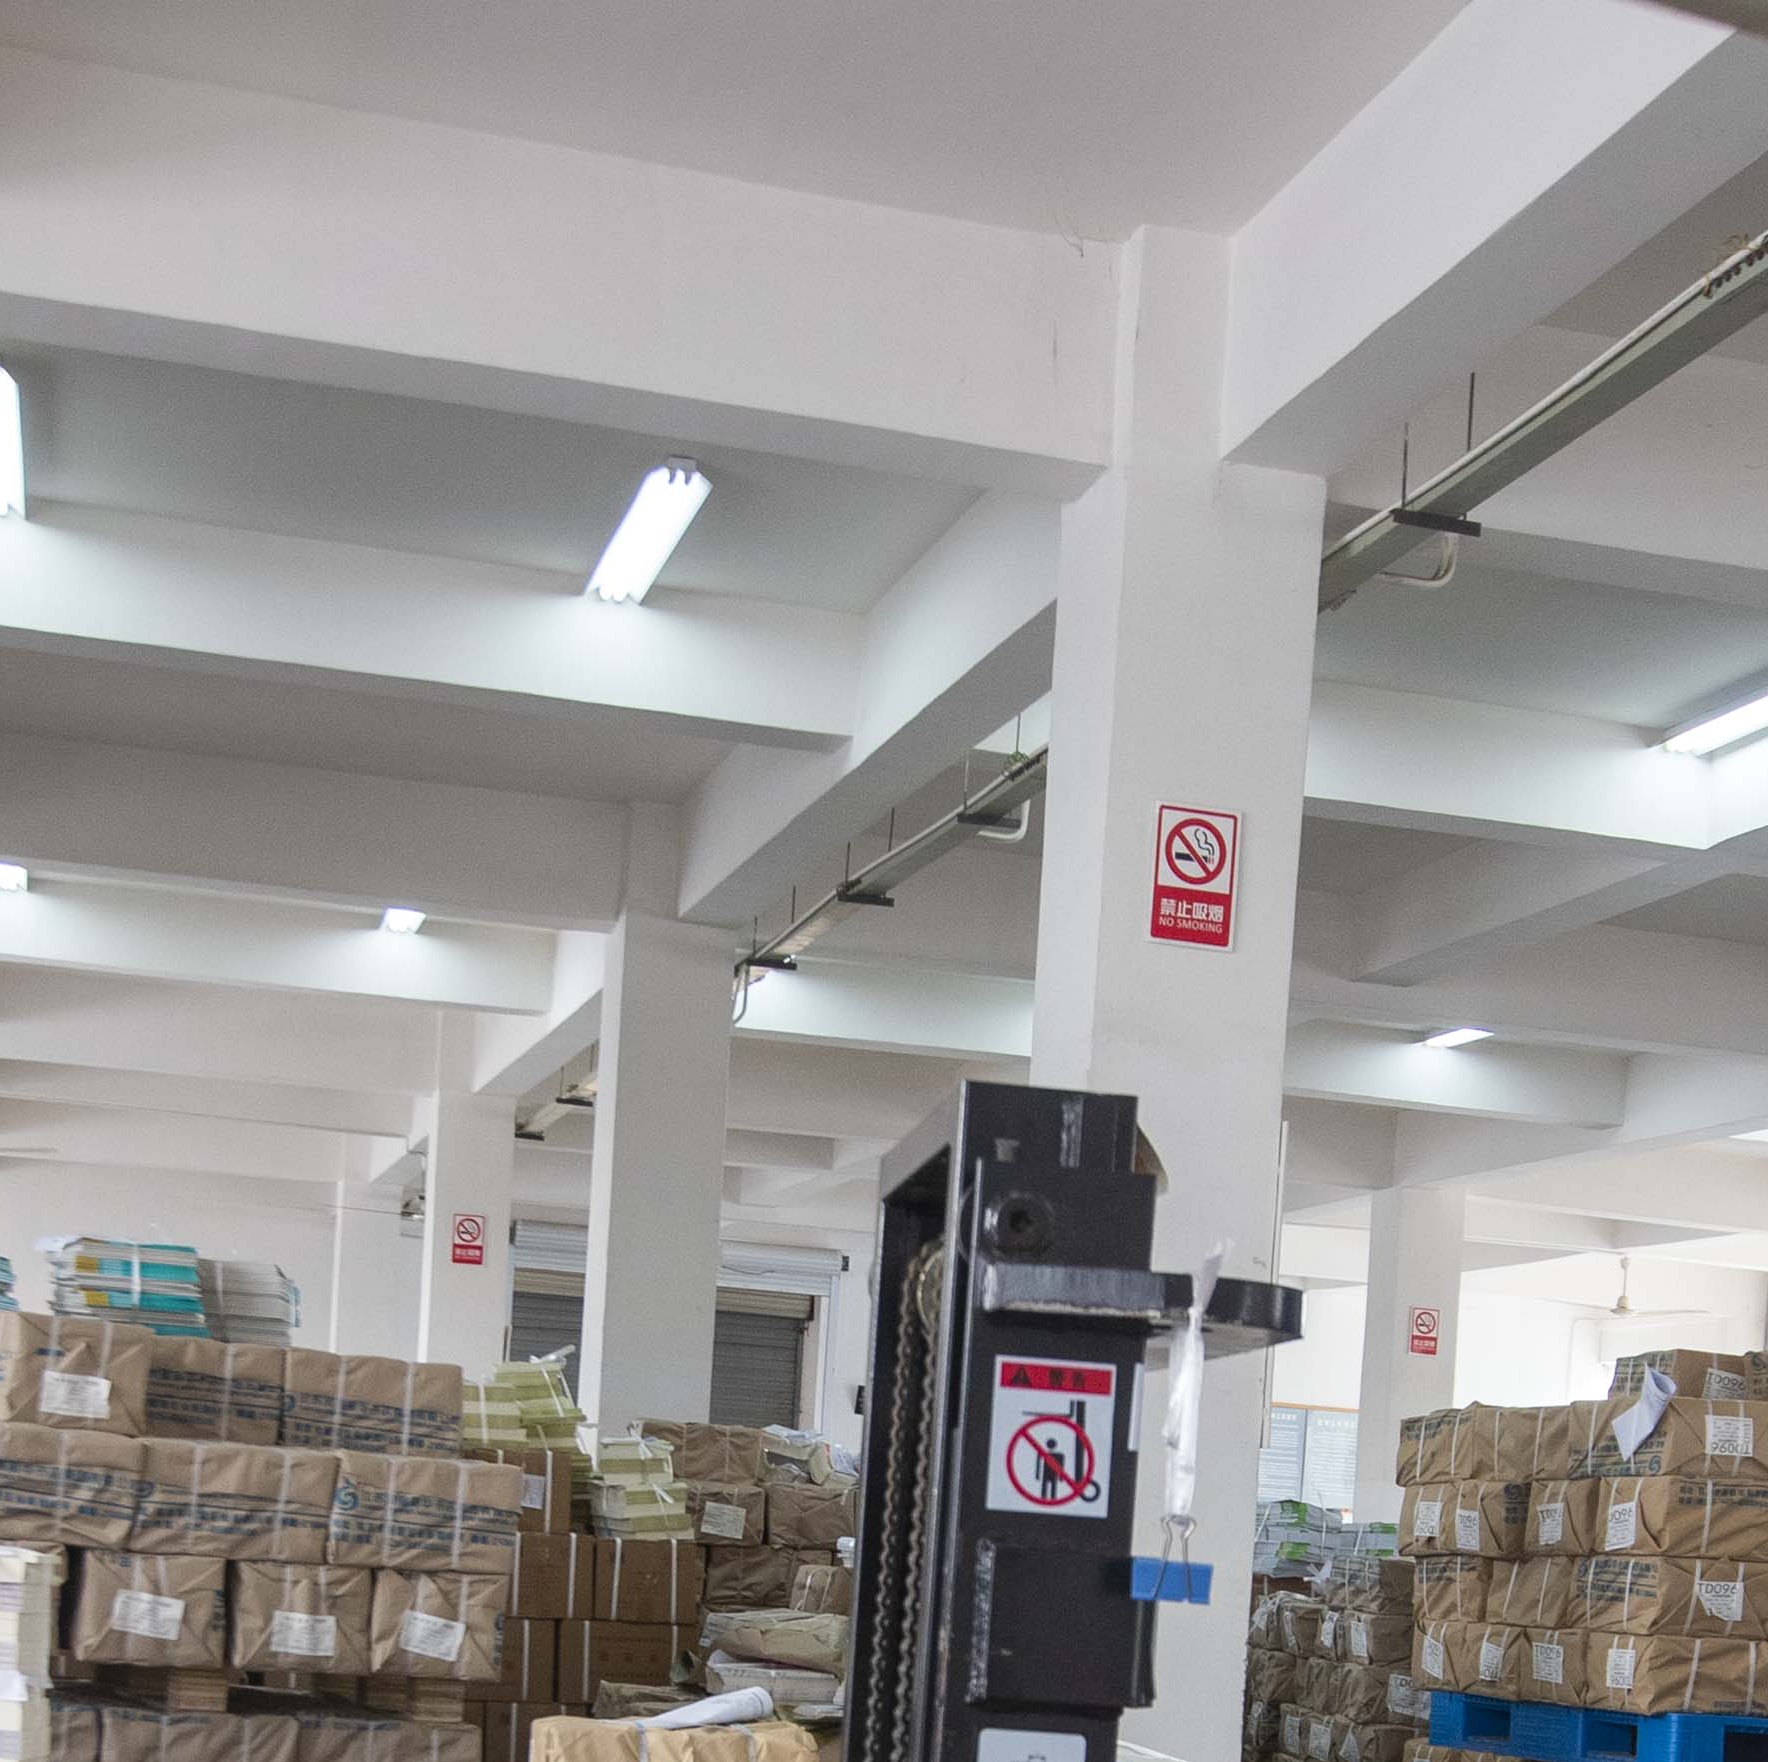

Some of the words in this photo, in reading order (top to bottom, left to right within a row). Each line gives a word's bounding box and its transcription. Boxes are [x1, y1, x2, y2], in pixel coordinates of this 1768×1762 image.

[1160, 898, 1224, 923] 禁止吸烟
[1159, 916, 1174, 928] NO
[1176, 917, 1223, 934] SMOKING
[1698, 1582, 1738, 1596] TD096
